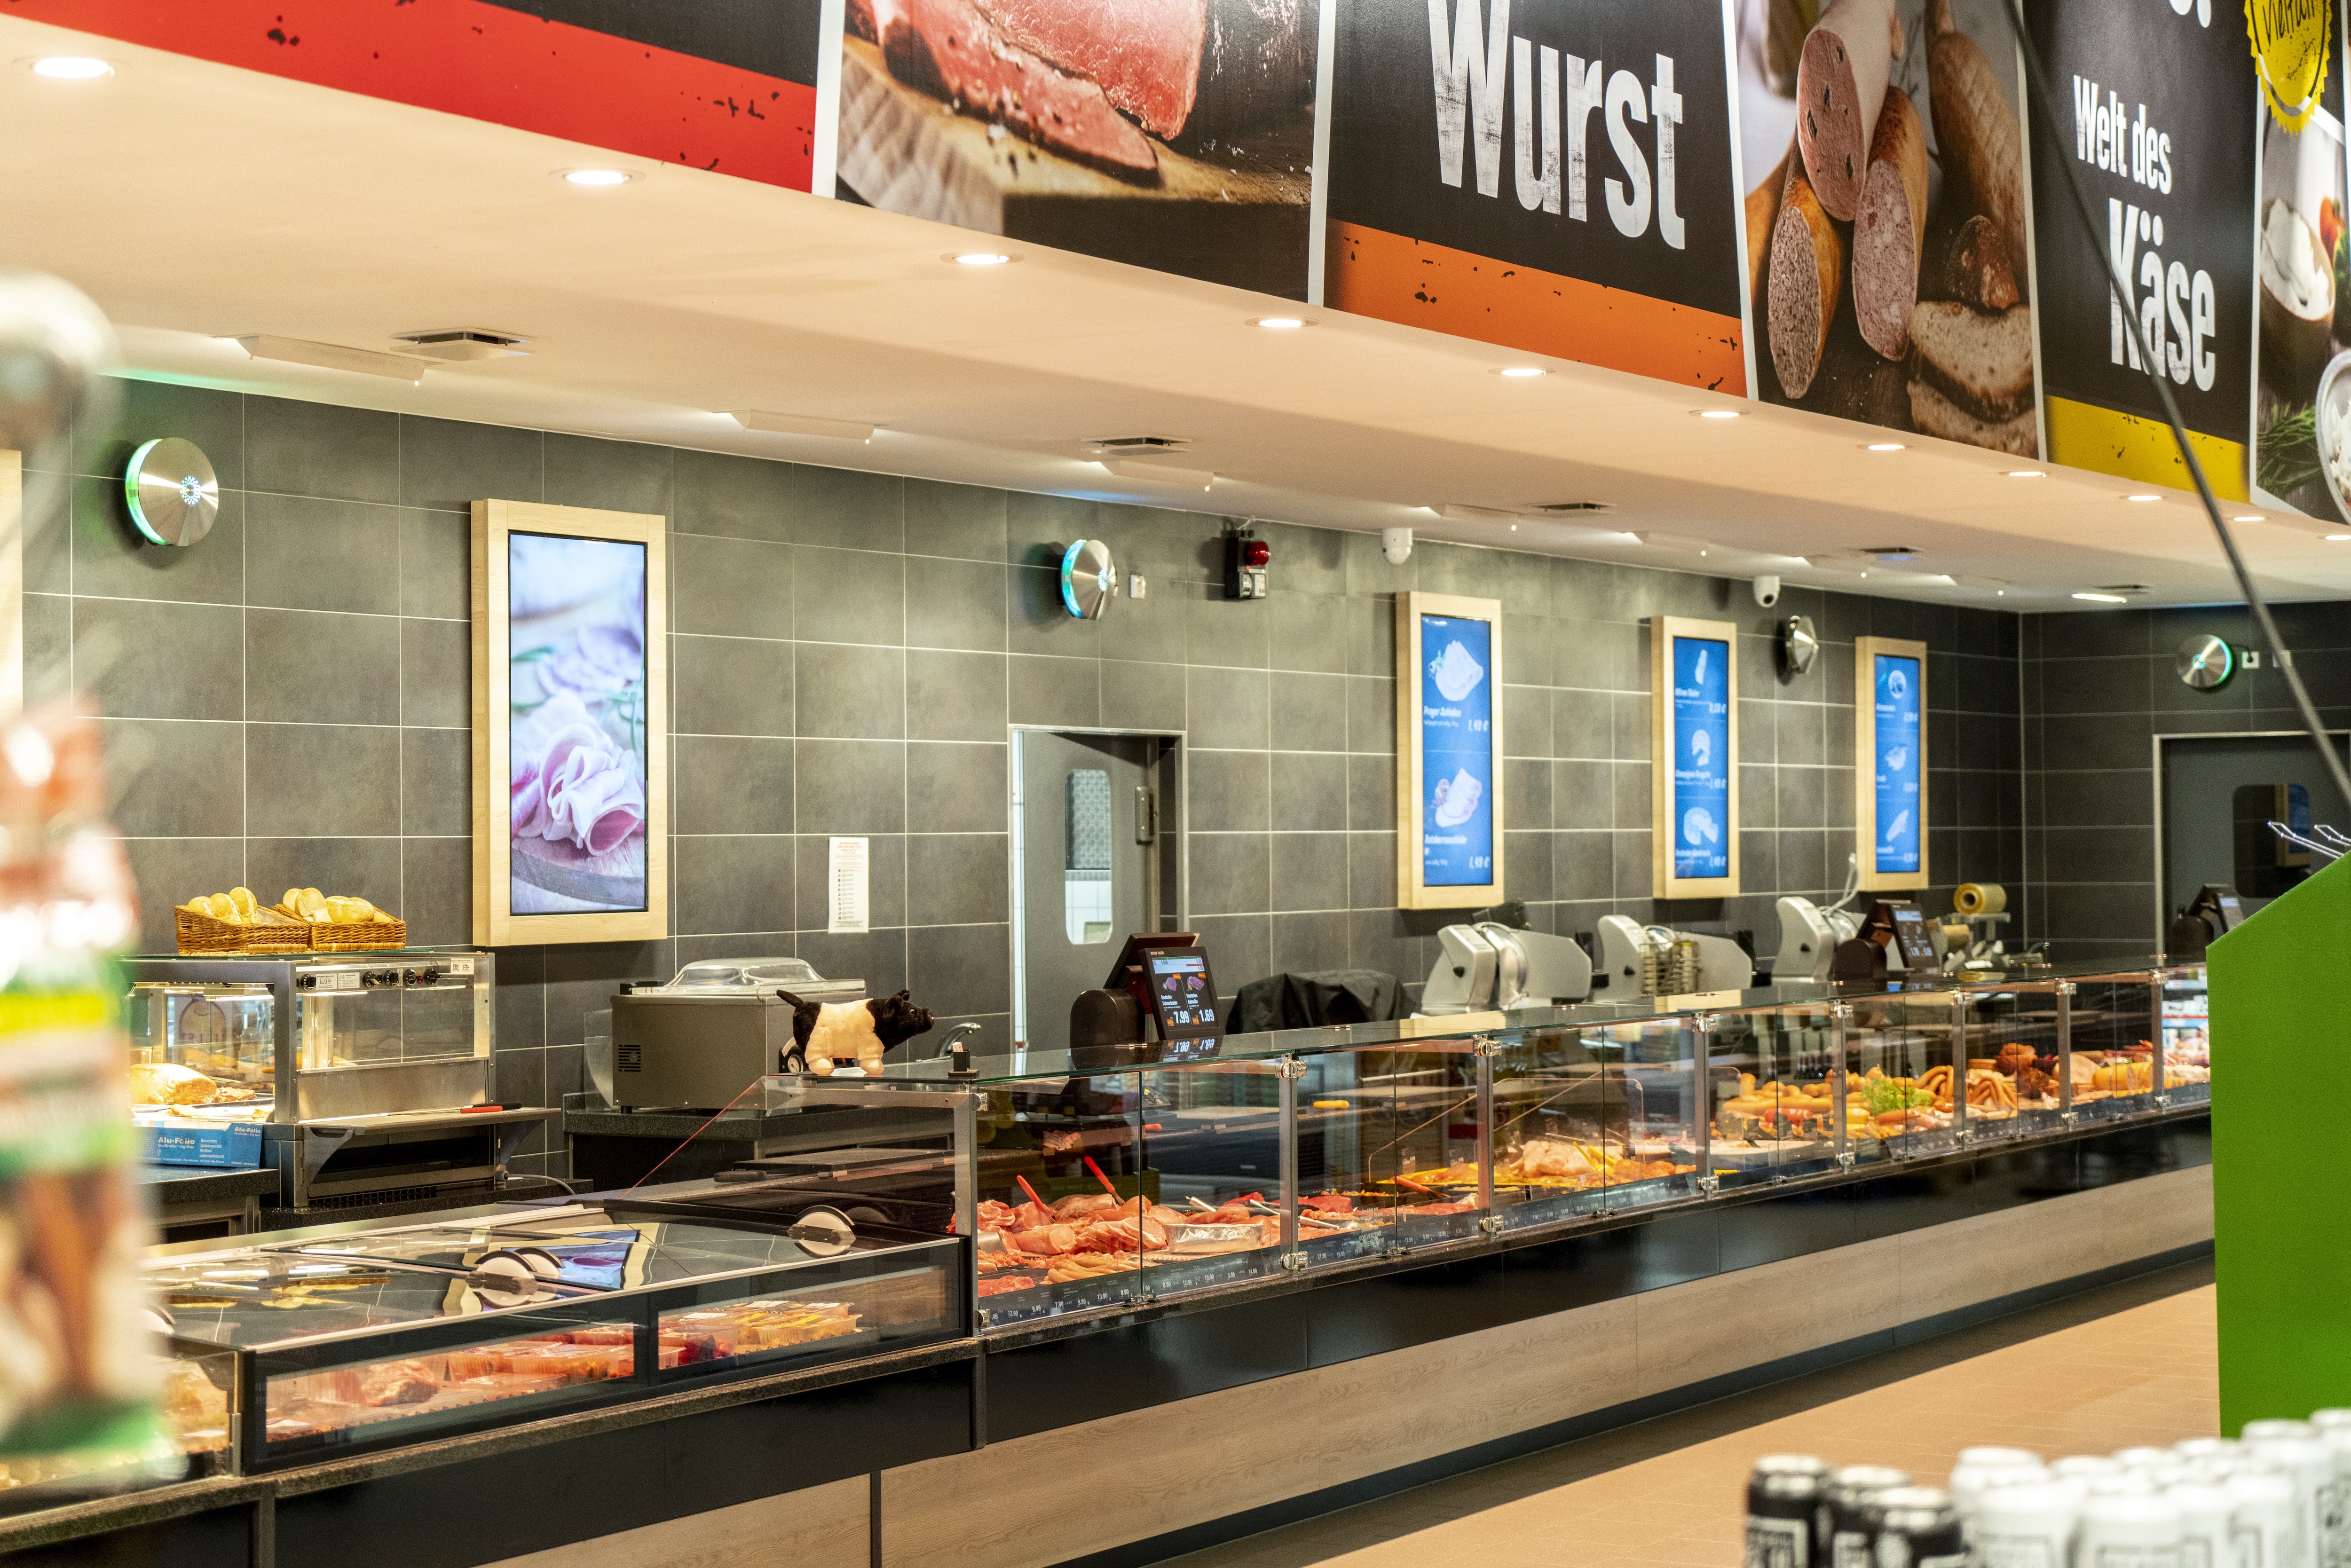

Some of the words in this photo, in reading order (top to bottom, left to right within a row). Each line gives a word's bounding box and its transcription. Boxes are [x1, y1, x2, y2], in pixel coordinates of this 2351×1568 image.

[1428, 0, 1685, 250] Wurst
[2073, 74, 2127, 178] Welt
[2132, 103, 2172, 195] des
[2109, 197, 2216, 392] Käse
[1173, 1010, 1190, 1024] 7.99
[1199, 1009, 1215, 1022] 1.69
